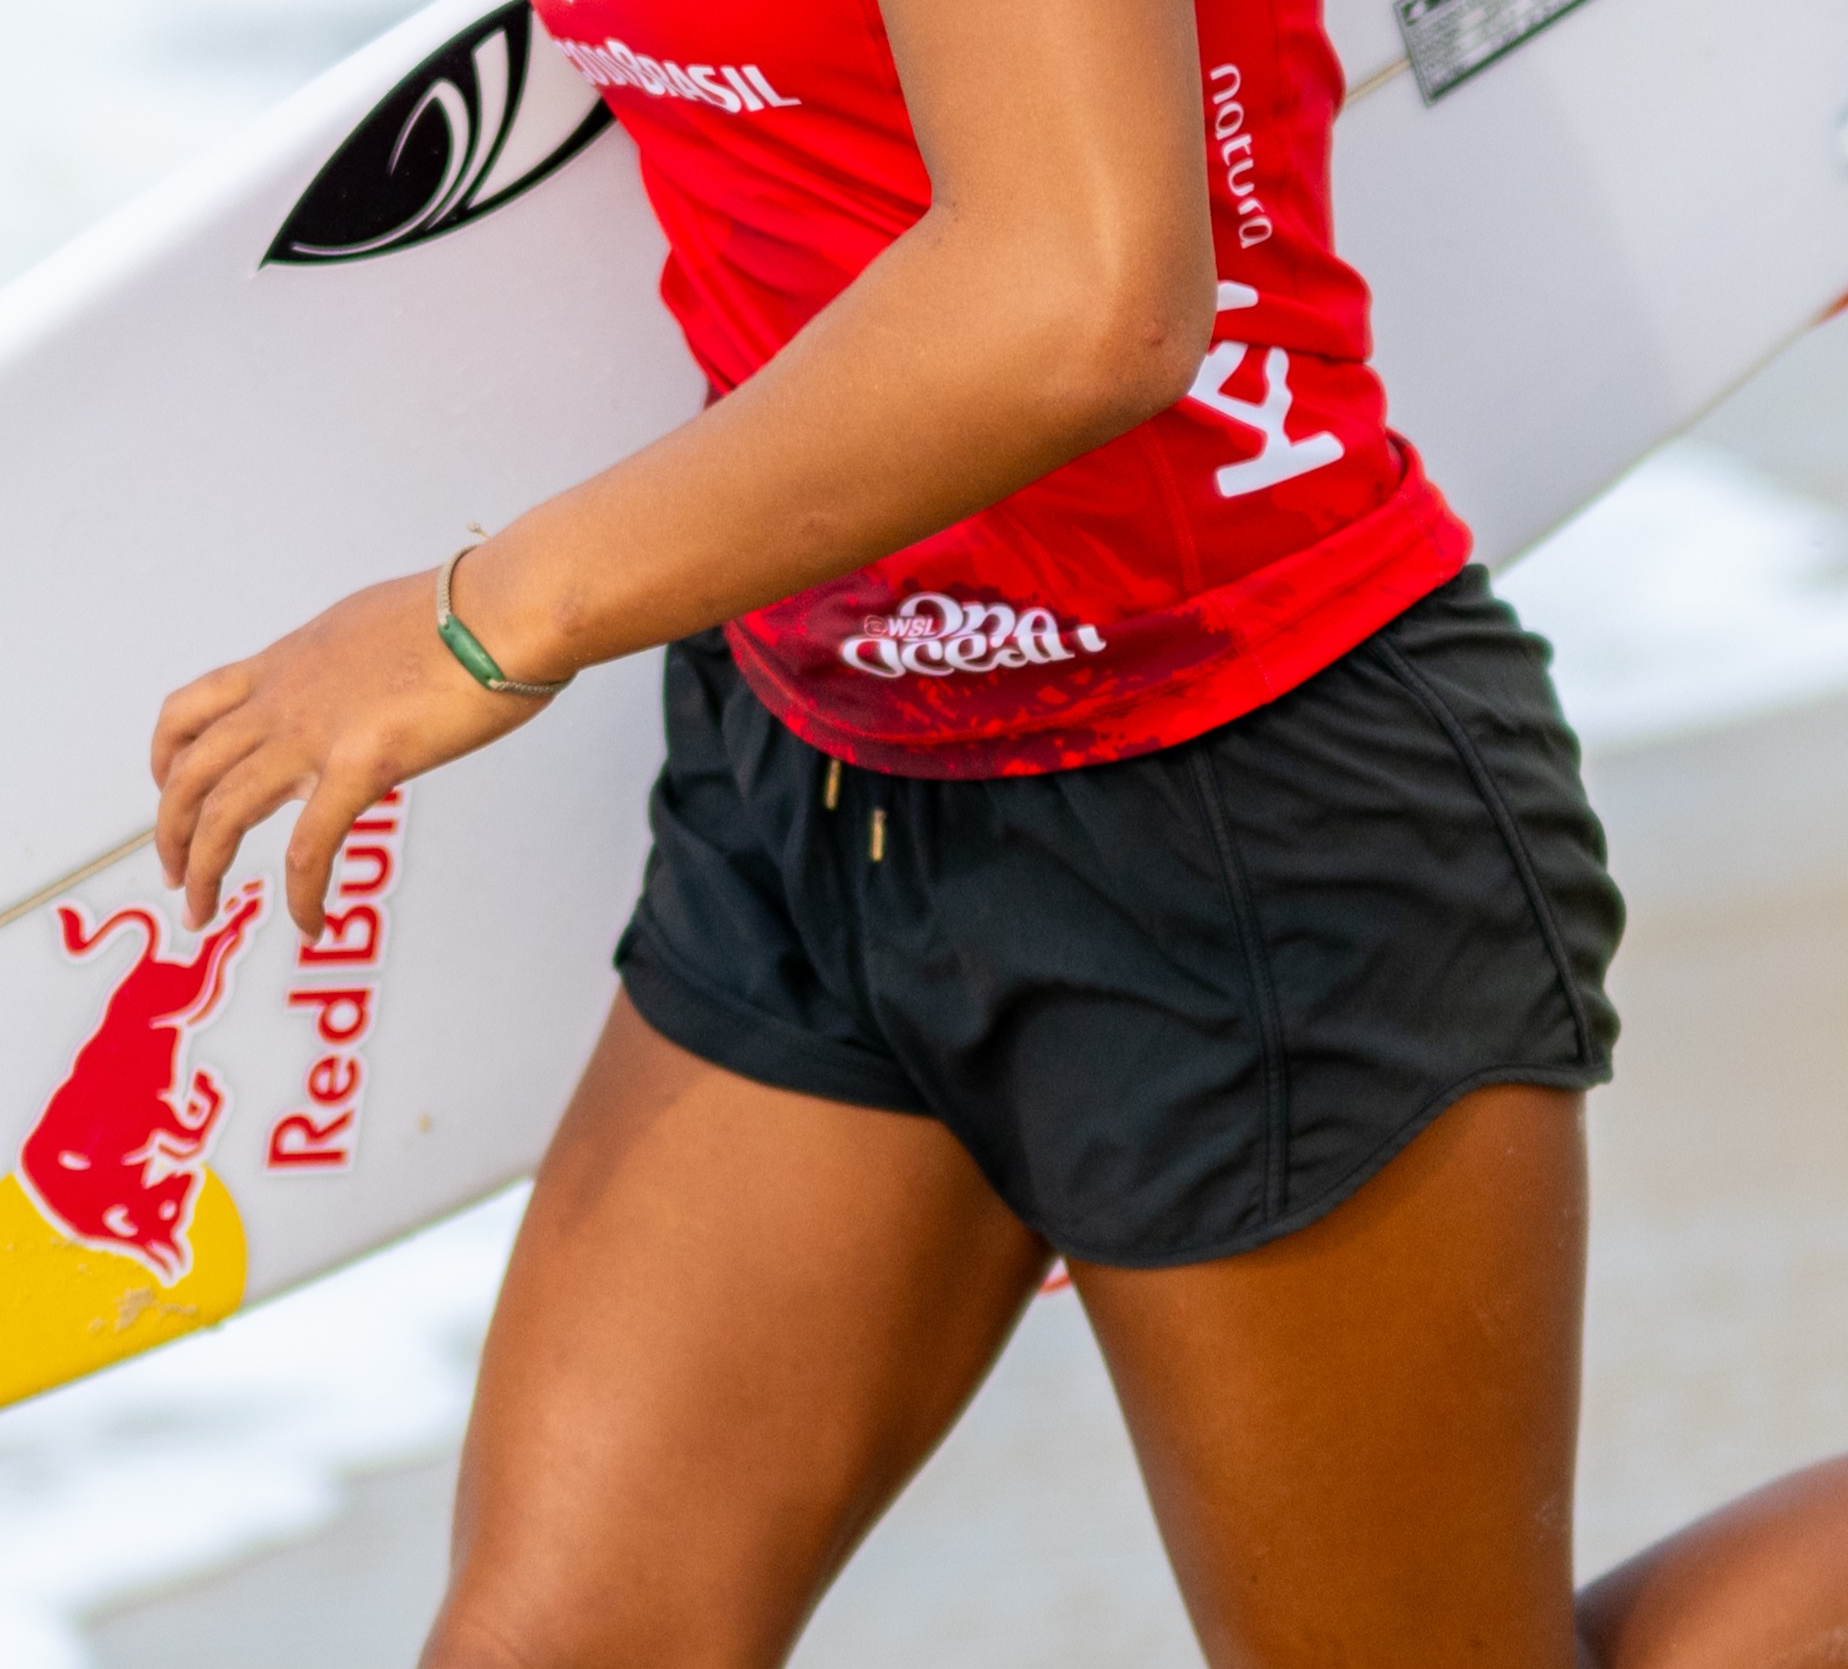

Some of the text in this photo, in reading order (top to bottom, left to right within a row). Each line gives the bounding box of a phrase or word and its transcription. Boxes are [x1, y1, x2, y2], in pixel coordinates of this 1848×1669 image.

[1209, 61, 1273, 250] natura
[887, 615, 937, 638] WSL
[266, 786, 402, 1170] Red Bul
